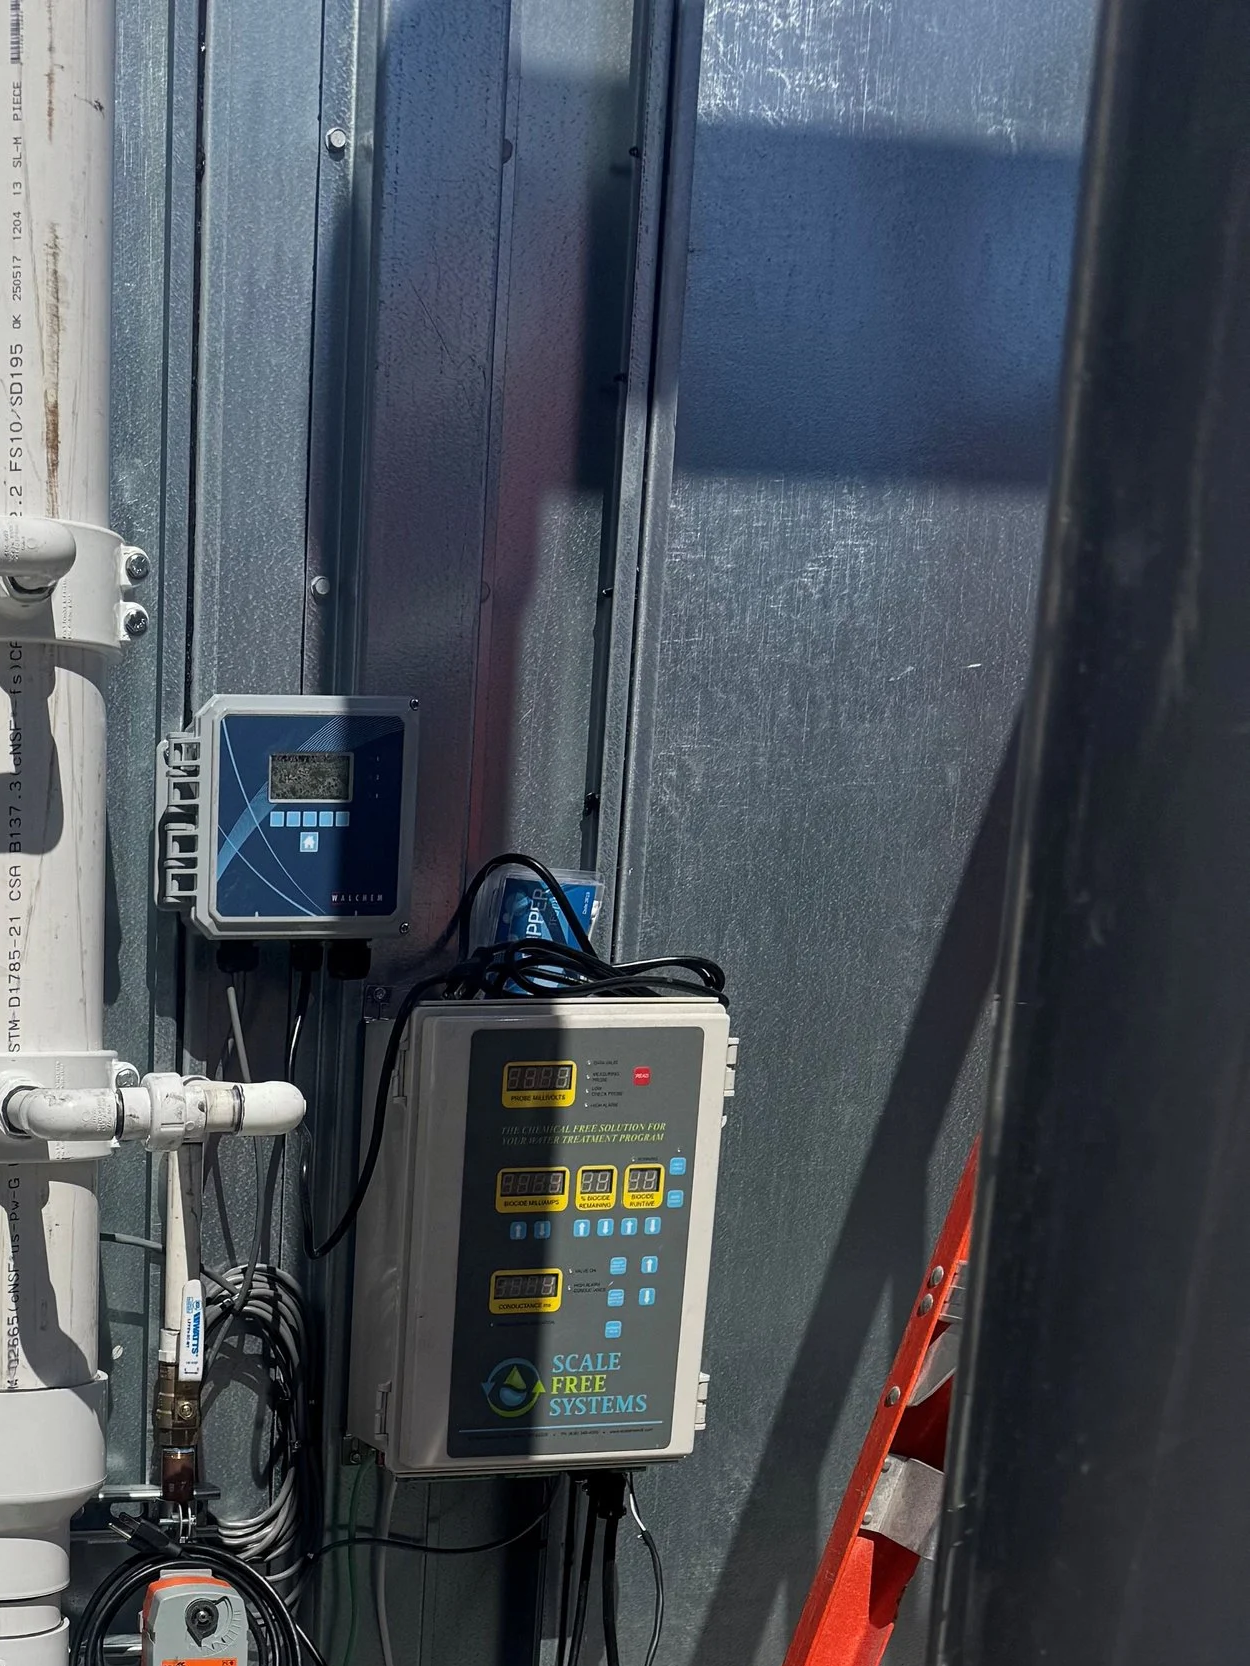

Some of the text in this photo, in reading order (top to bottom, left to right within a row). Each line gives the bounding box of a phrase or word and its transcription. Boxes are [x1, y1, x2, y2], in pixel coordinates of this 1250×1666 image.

[12, 81, 22, 121] PIECE
[13, 136, 22, 168] SL-M
[13, 181, 21, 196] 13
[13, 211, 21, 240] 1204
[12, 256, 21, 301] 250517
[13, 314, 21, 329] OK
[10, 344, 23, 472] FS10/SD195
[9, 865, 21, 901] CSA
[8, 915, 21, 1053] STM-D1785-21
[502, 1122, 666, 1135] THE CHEMICAL FREE SOLUTION FOR
[502, 1133, 664, 1145] YOUR WATER TREATMENT PROGRAM
[191, 1313, 200, 1355] WATTS
[552, 1353, 621, 1373] SCALE
[551, 1375, 607, 1394] FREE
[549, 1394, 647, 1416] SYSTEMS
